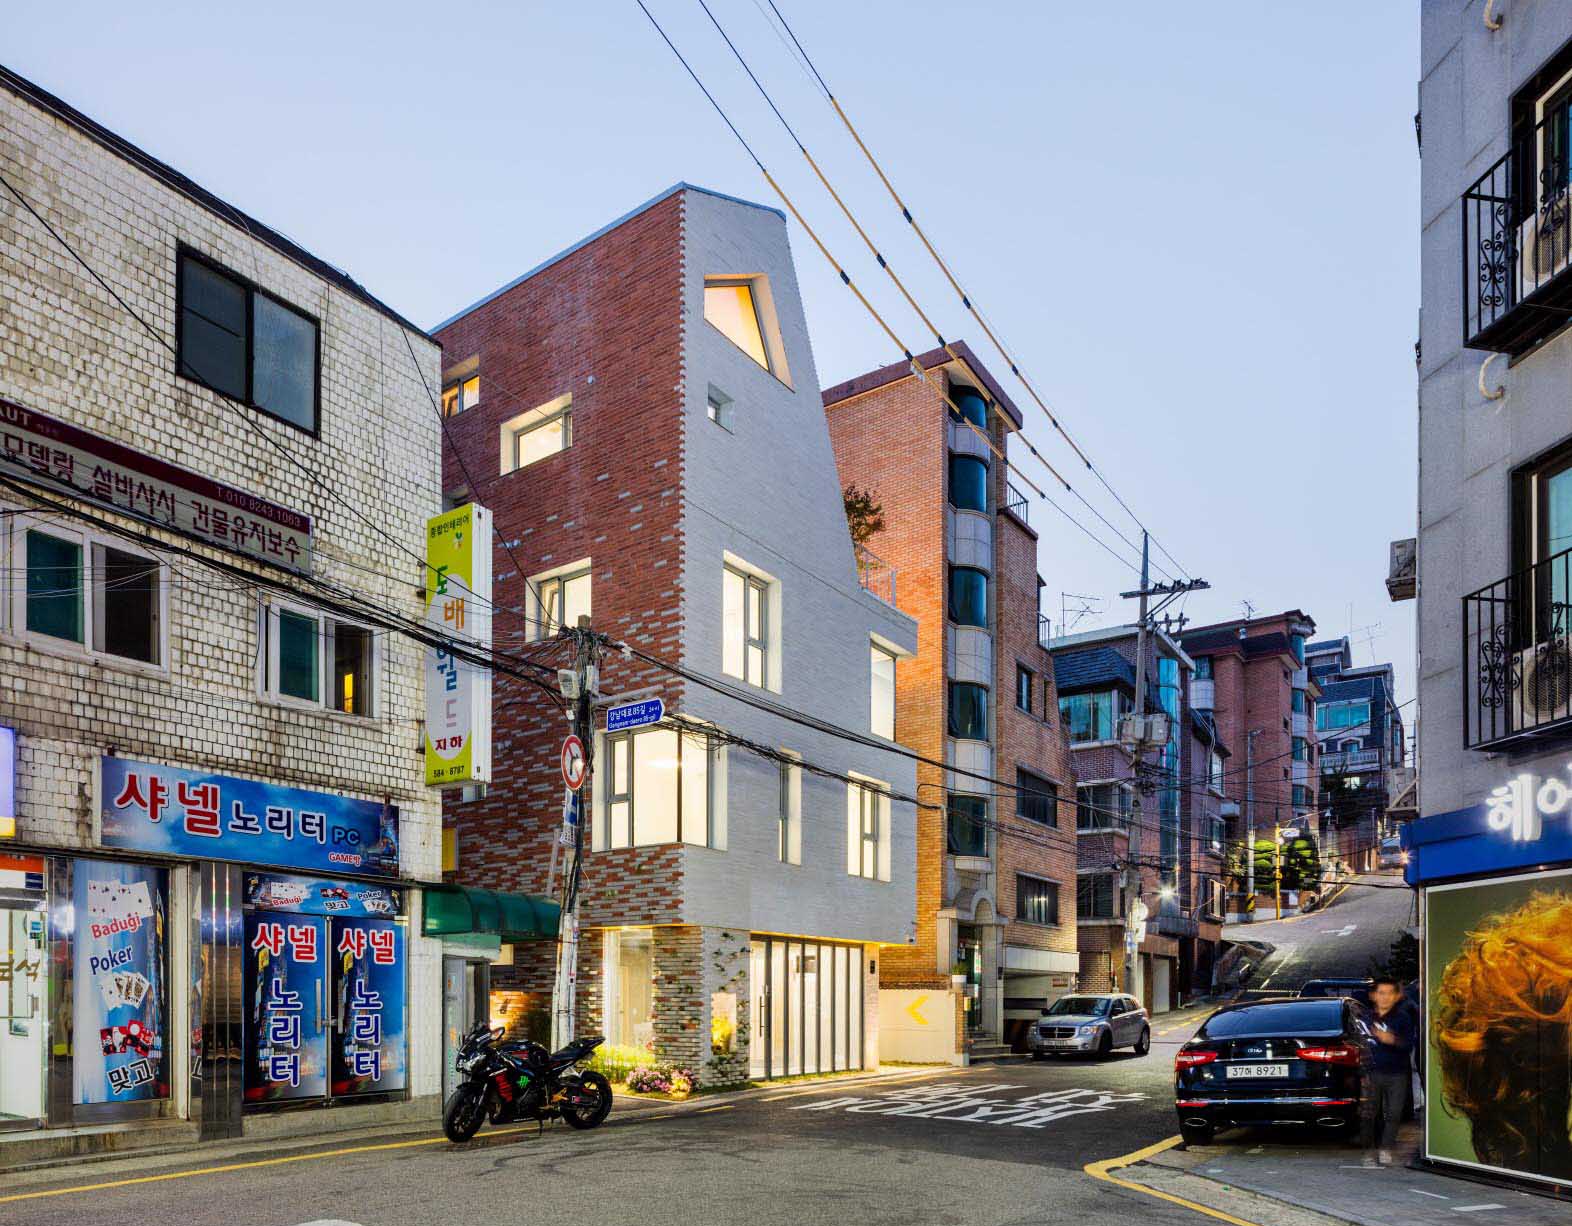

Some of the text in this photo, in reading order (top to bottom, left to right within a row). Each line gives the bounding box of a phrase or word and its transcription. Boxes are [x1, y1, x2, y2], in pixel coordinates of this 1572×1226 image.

[191, 500, 300, 563] 건물유지보수
[115, 772, 361, 846] 샤넬 노리터 PC
[271, 897, 302, 908] Badugi
[357, 890, 383, 900] Poker
[90, 913, 142, 940] Badugi
[252, 922, 317, 963] 샤넬
[90, 945, 133, 976] Poker
[338, 928, 396, 964] 샤넬
[267, 977, 303, 1087] 노리터
[352, 978, 384, 1081] 노리터
[107, 1058, 155, 1095] 맞고
[1256, 1065, 1282, 1076] 8921
